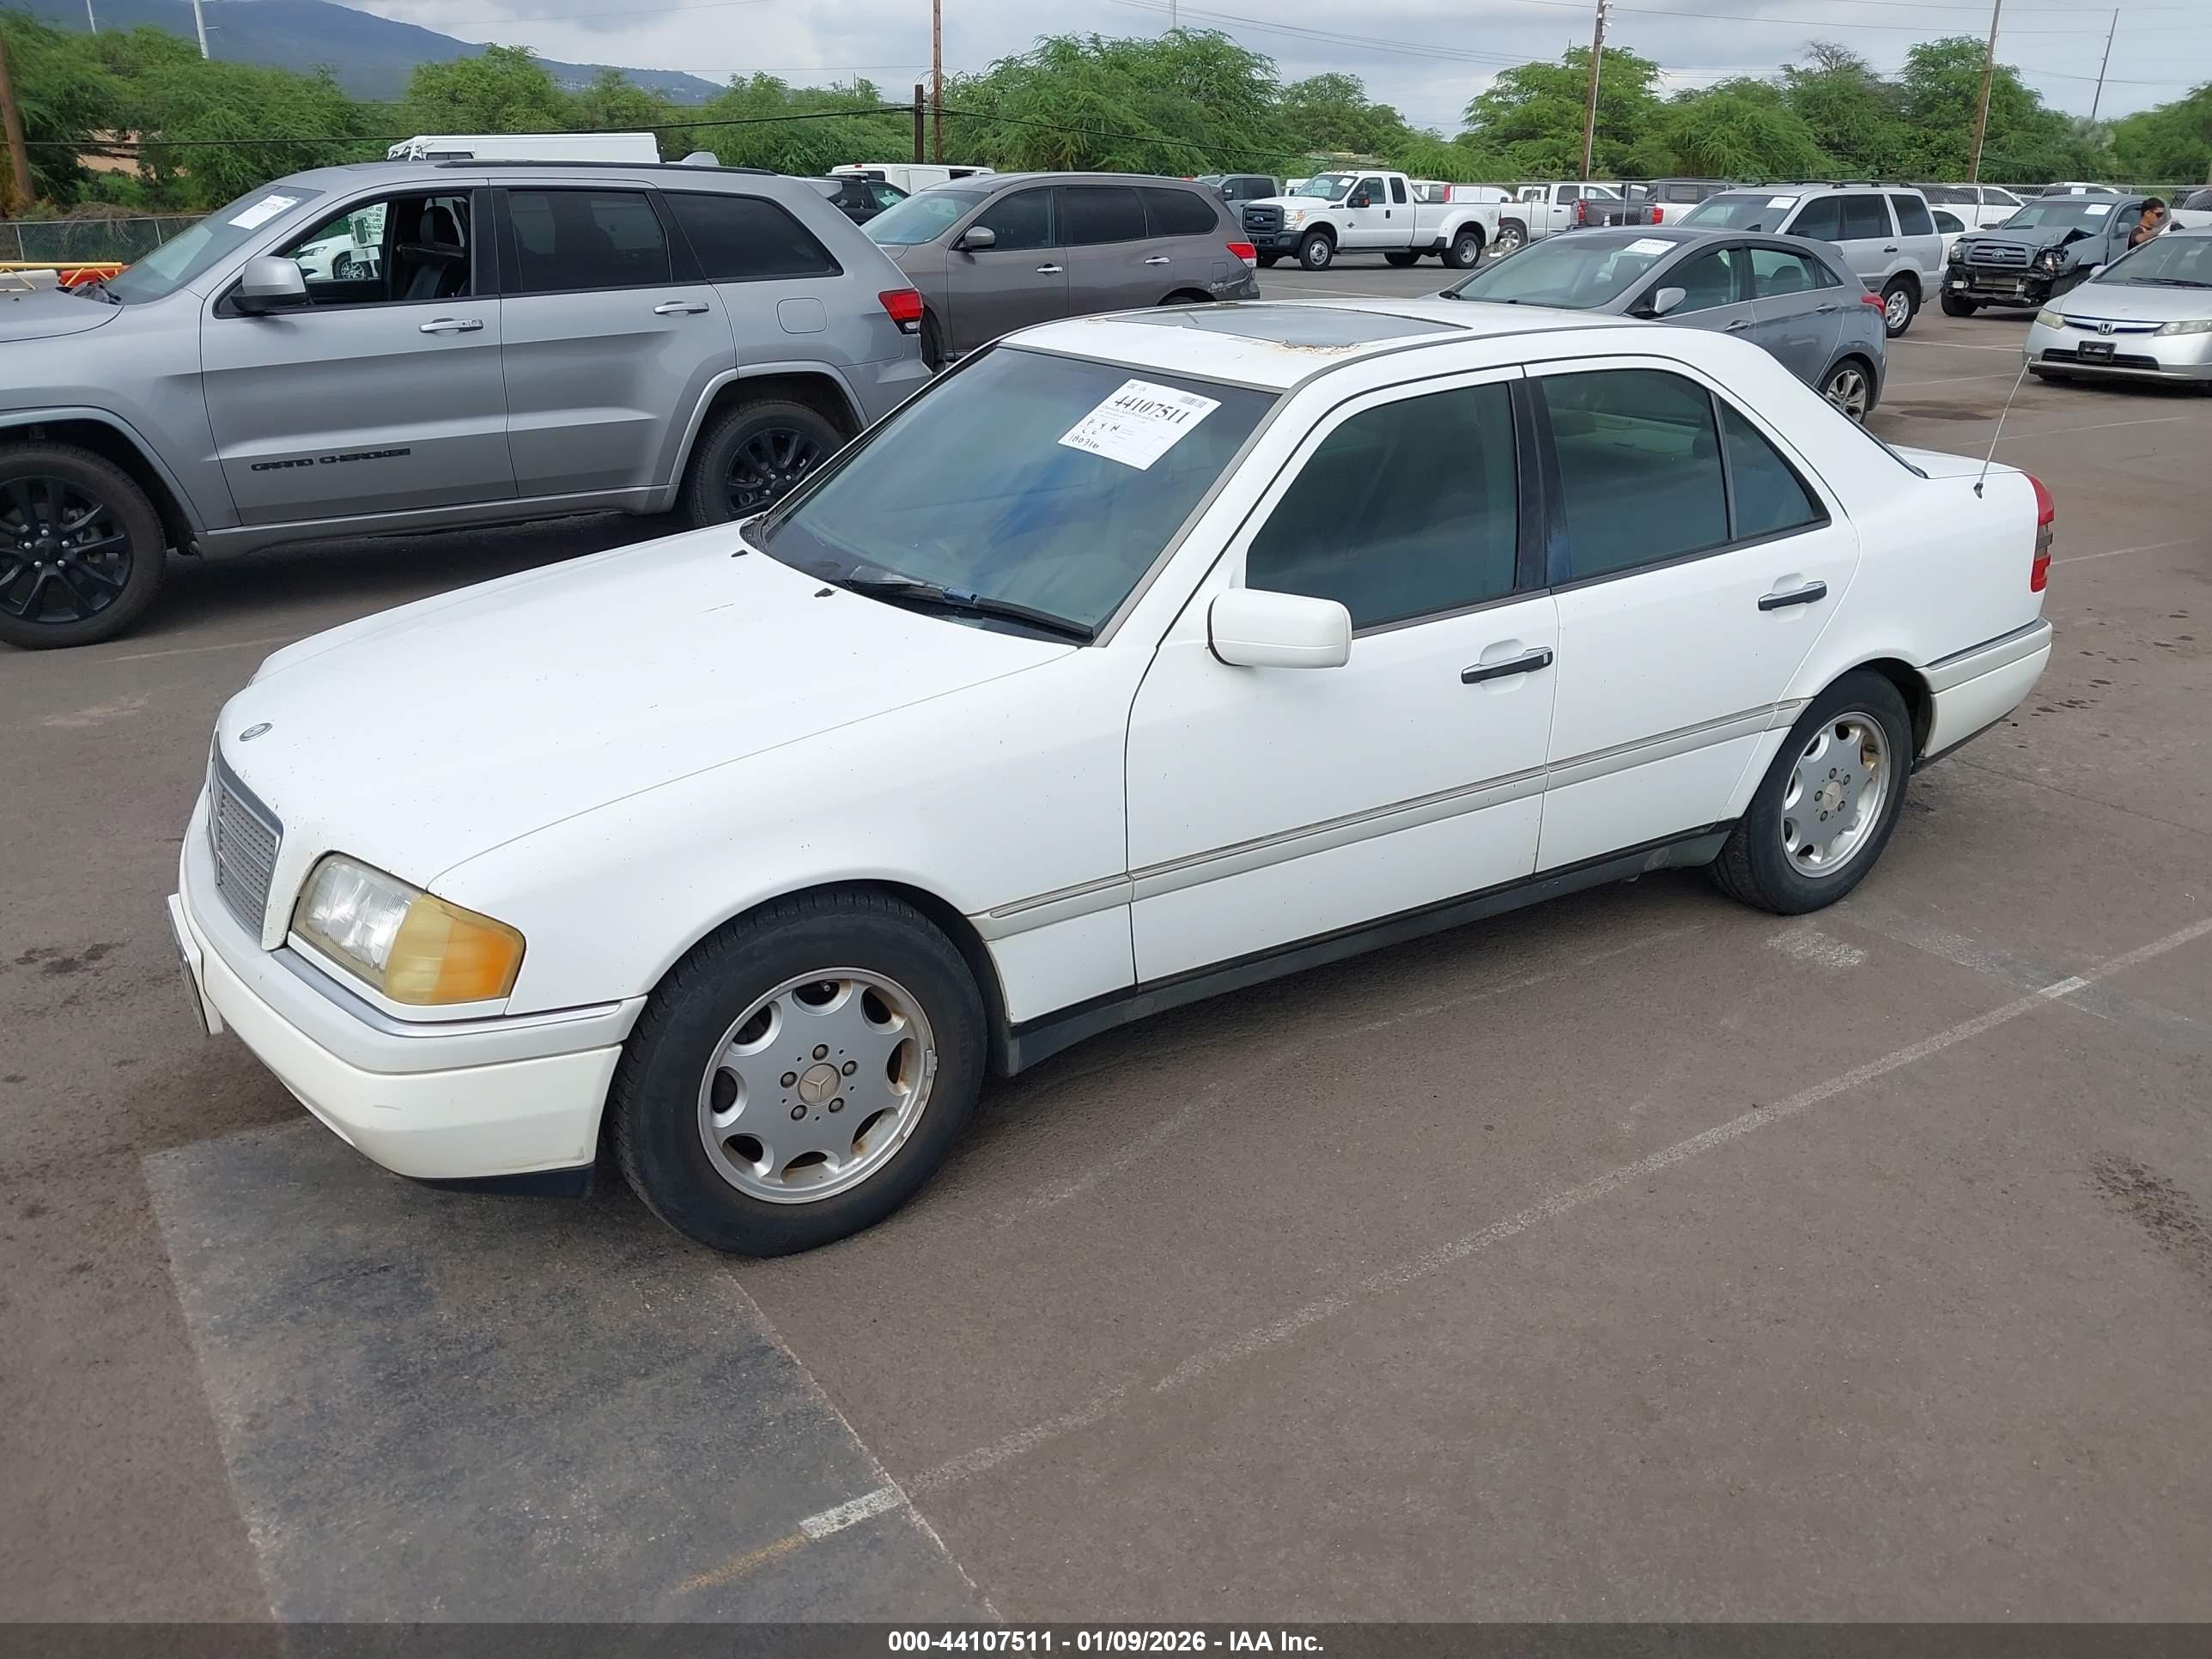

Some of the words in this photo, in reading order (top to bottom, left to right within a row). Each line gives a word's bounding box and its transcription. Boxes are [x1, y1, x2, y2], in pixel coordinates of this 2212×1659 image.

[1114, 394, 1191, 424] 44107511
[251, 458, 314, 471] GRAND
[319, 447, 412, 465] CHEROKEE
